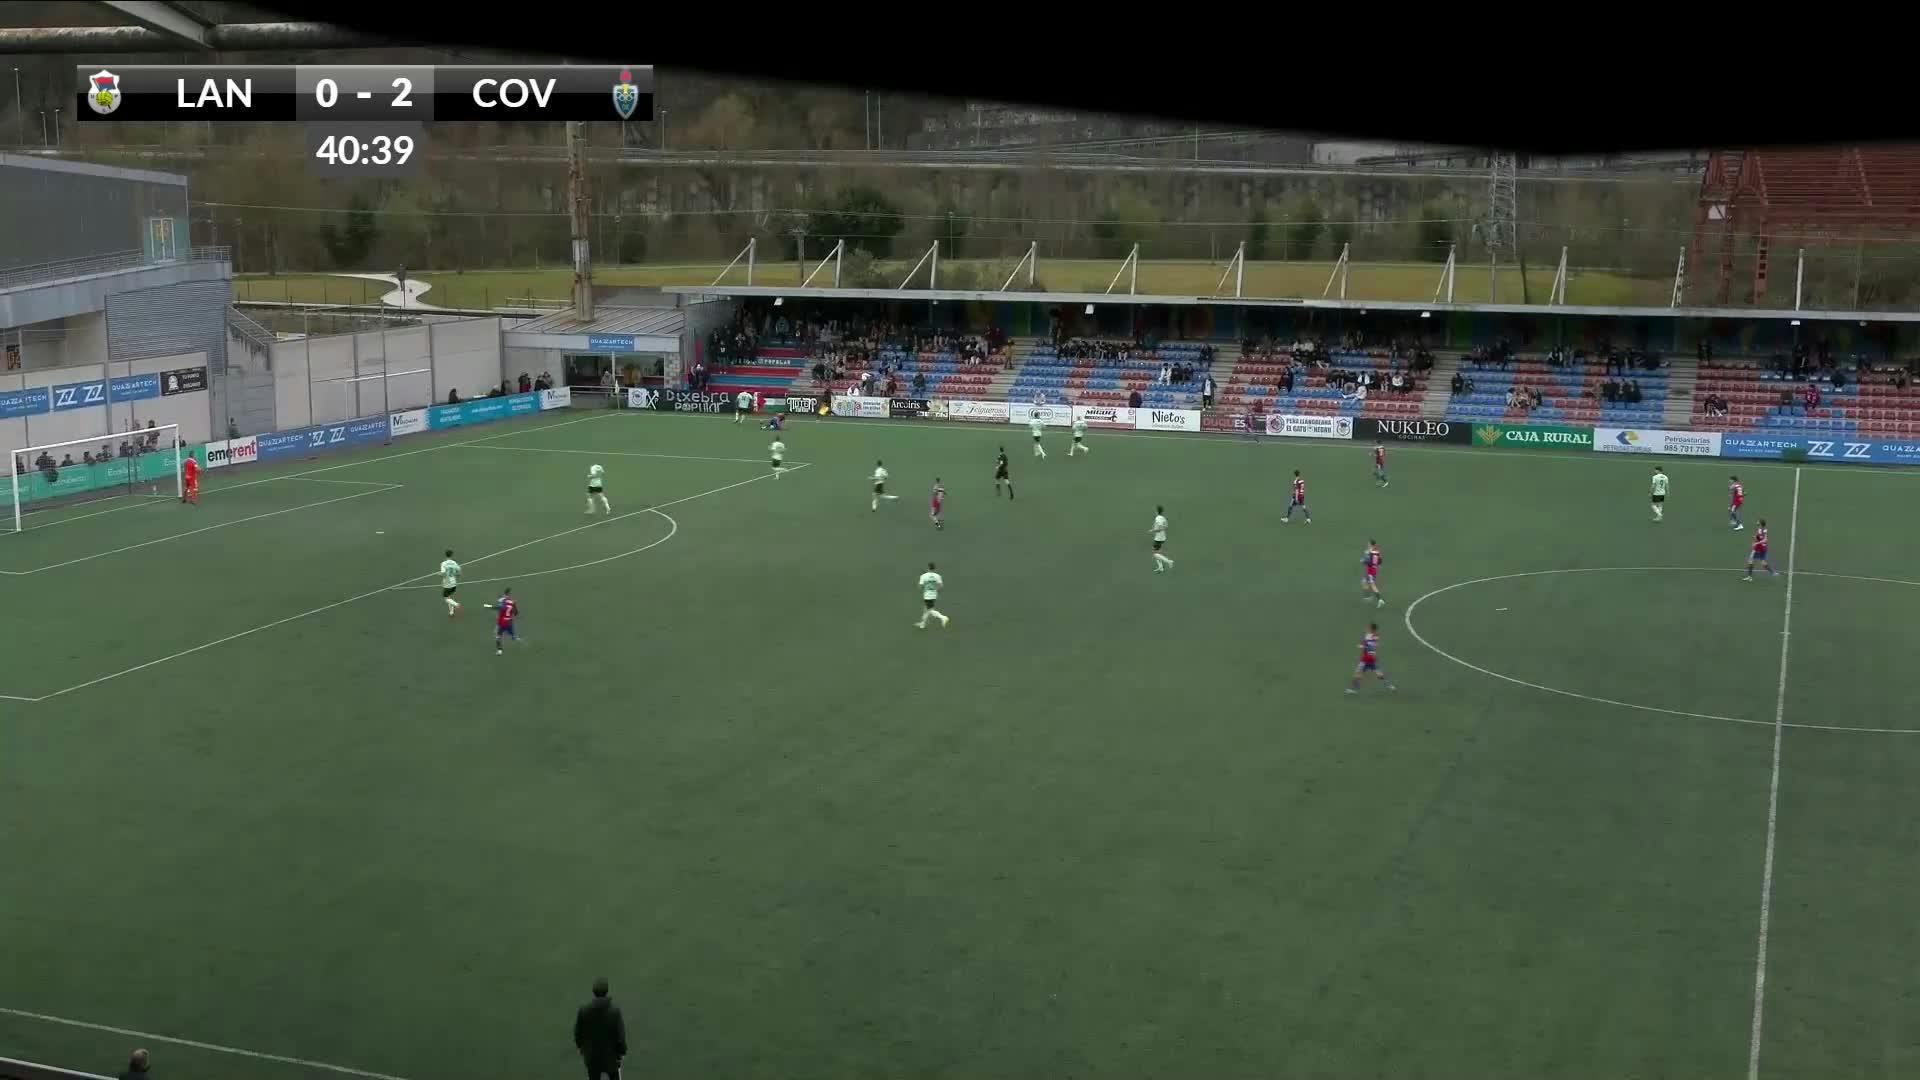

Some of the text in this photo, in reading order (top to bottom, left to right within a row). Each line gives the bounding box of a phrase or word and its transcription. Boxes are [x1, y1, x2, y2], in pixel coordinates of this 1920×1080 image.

[1152, 411, 1186, 424] Nieto's
[1377, 420, 1450, 436] NUKLEO
[1506, 430, 1592, 445] CAJA RURAL
